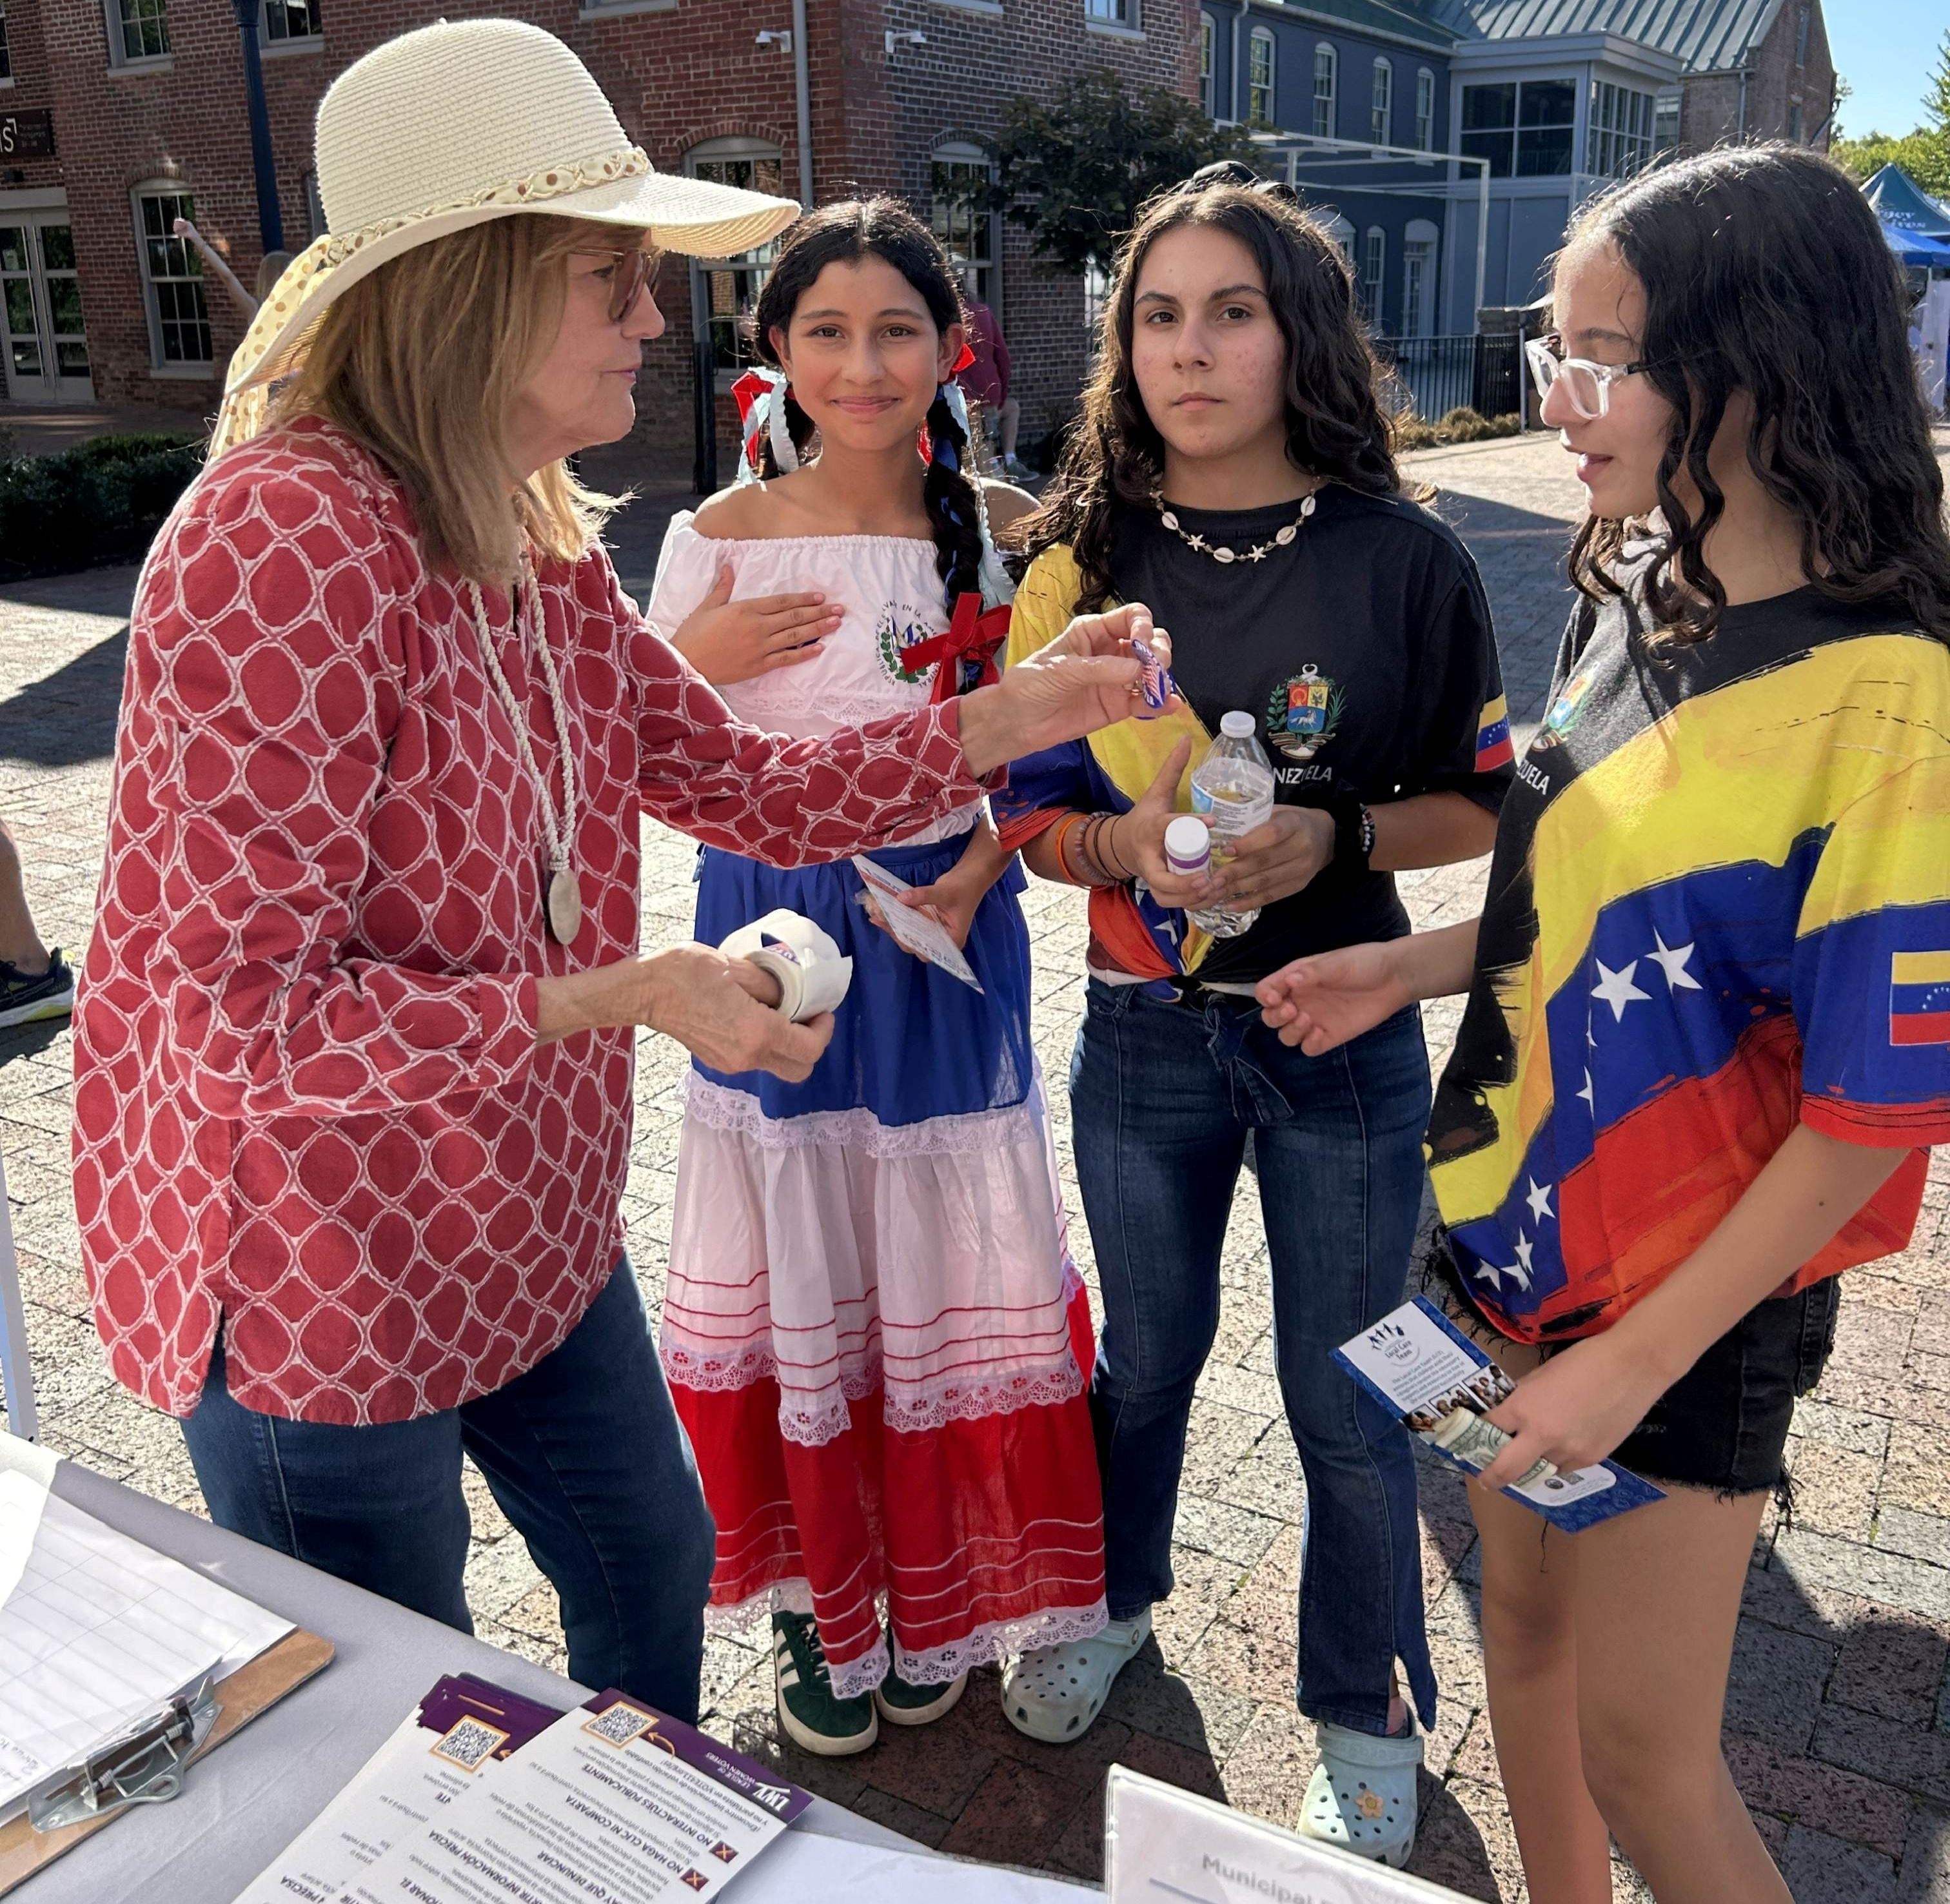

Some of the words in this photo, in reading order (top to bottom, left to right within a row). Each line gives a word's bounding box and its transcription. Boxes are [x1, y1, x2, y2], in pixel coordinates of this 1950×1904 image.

[902, 603, 912, 612] EN
[914, 609, 921, 618] LA
[1516, 759, 1550, 796] ZUELA
[1384, 1346, 1399, 1359] Local
[1397, 1339, 1412, 1350] Care
[1397, 1349, 1412, 1361] Team
[704, 1750, 731, 1769] VOTERS
[581, 1762, 642, 1804] PÚBLICAMENTE
[724, 1769, 751, 1789] LEAGUE
[727, 1763, 756, 1784] WOMEN
[678, 1779, 688, 1789] de
[713, 1789, 724, 1799] en
[751, 1780, 789, 1812] LWV
[564, 1794, 613, 1829] COMPARTA
[753, 1812, 764, 1823] no
[609, 1822, 622, 1836] NI
[619, 1829, 642, 1848] CLIC
[427, 1829, 463, 1858] PRECISA
[695, 1832, 713, 1847] NO
[640, 1842, 668, 1865] HAGA
[459, 1850, 521, 1896] INFORMACIÓN
[536, 1849, 587, 1887] DENUNCIAR
[665, 1858, 684, 1874] NO
[278, 1874, 320, 1903] PRECISA
[399, 1876, 412, 1890] EL
[583, 1880, 607, 1900] QUE
